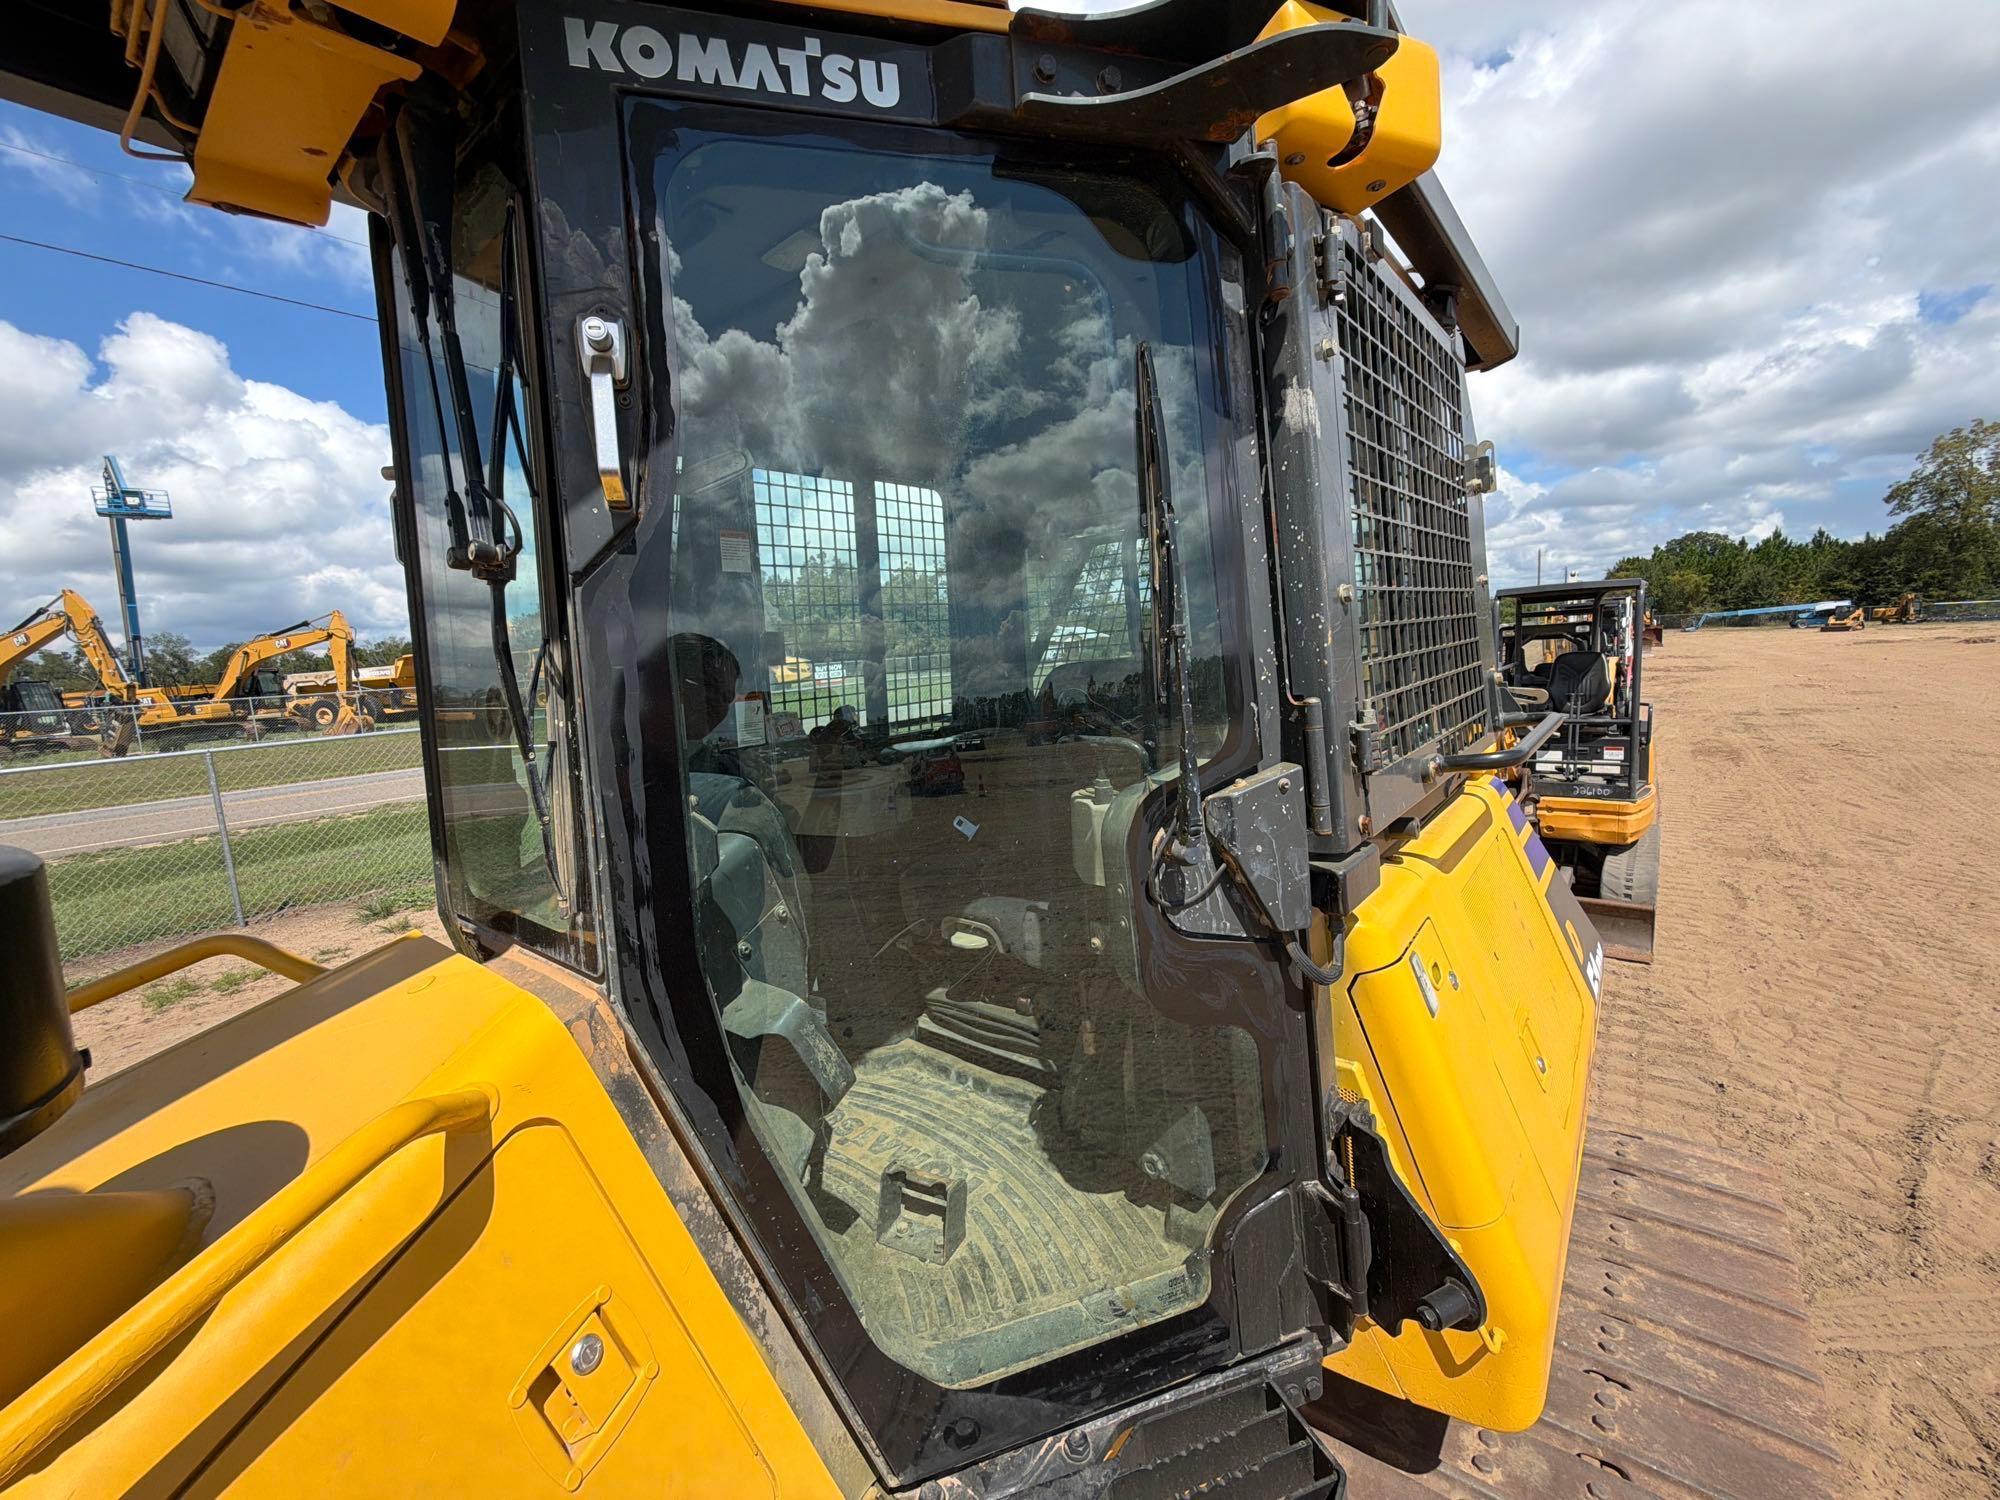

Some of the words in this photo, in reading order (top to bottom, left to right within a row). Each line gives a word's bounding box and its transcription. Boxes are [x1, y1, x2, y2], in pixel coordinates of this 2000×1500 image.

[564, 17, 900, 108] KOMATSU
[13, 633, 28, 647] CAT
[275, 638, 288, 649] CAT
